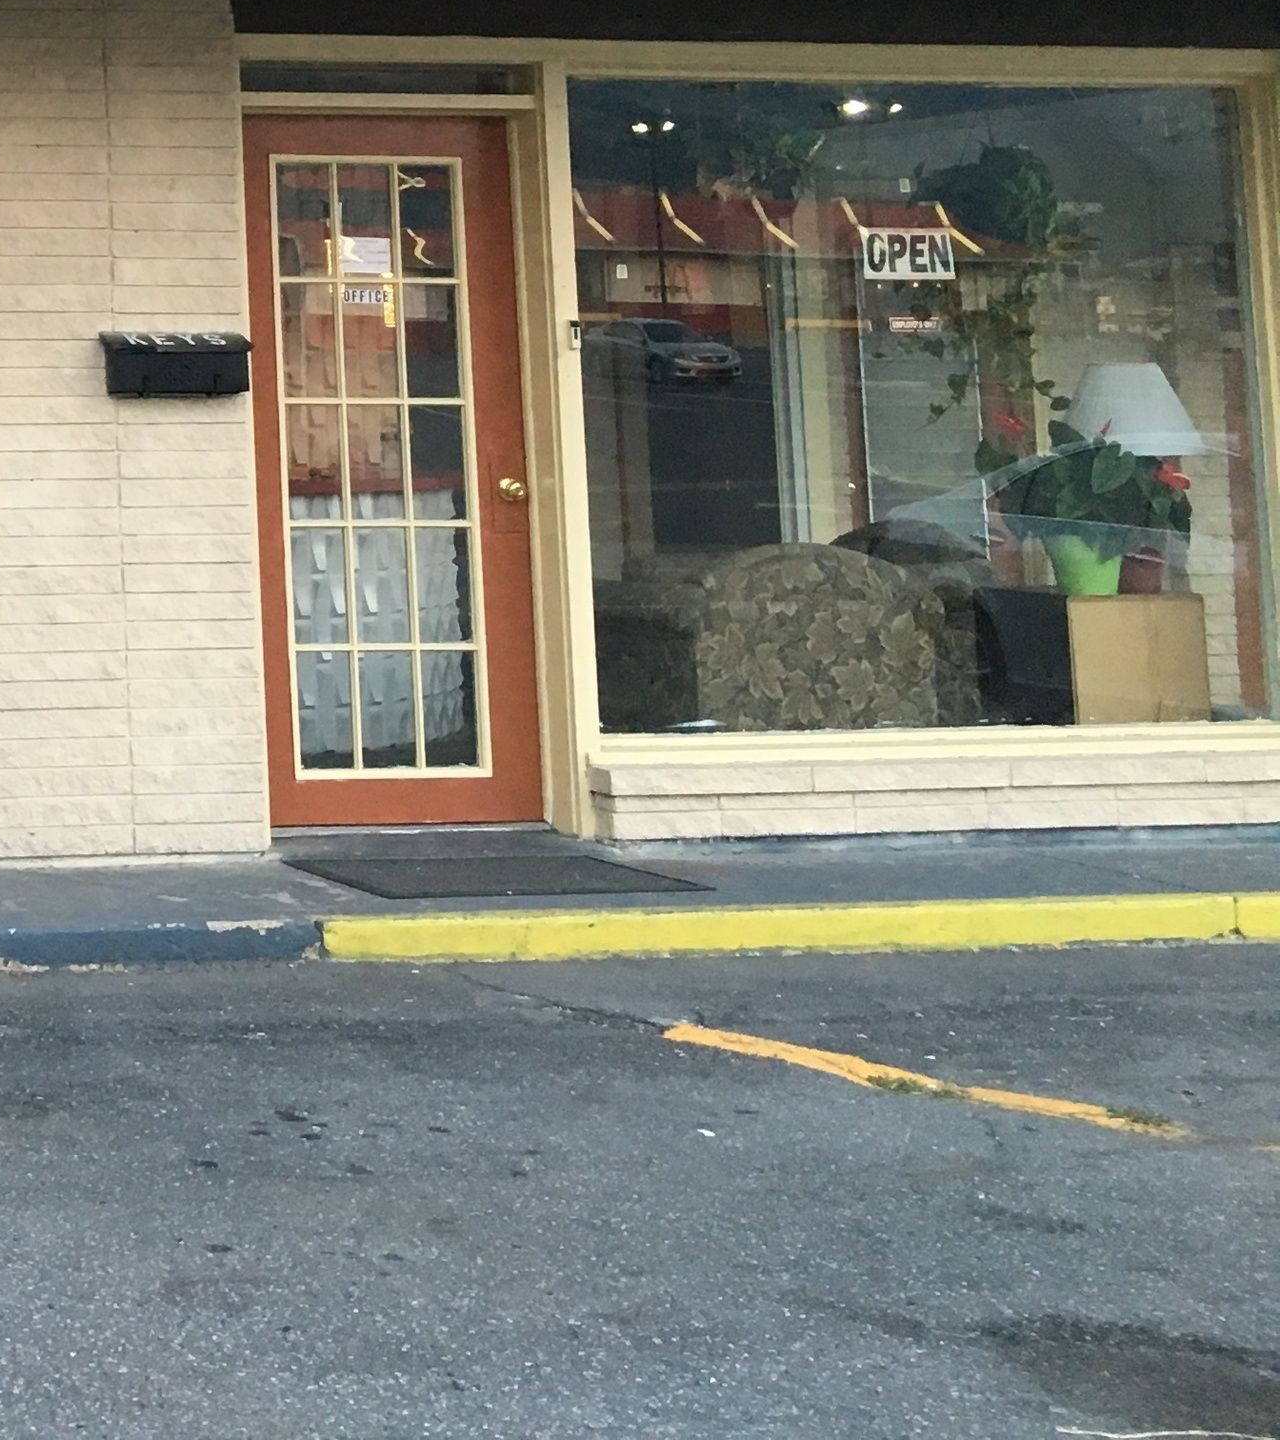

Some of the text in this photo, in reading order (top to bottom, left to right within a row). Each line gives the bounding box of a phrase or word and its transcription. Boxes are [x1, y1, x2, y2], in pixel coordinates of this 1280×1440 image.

[867, 233, 951, 273] OPEN
[343, 289, 389, 303] OFFICE
[122, 332, 227, 346] KEYS
